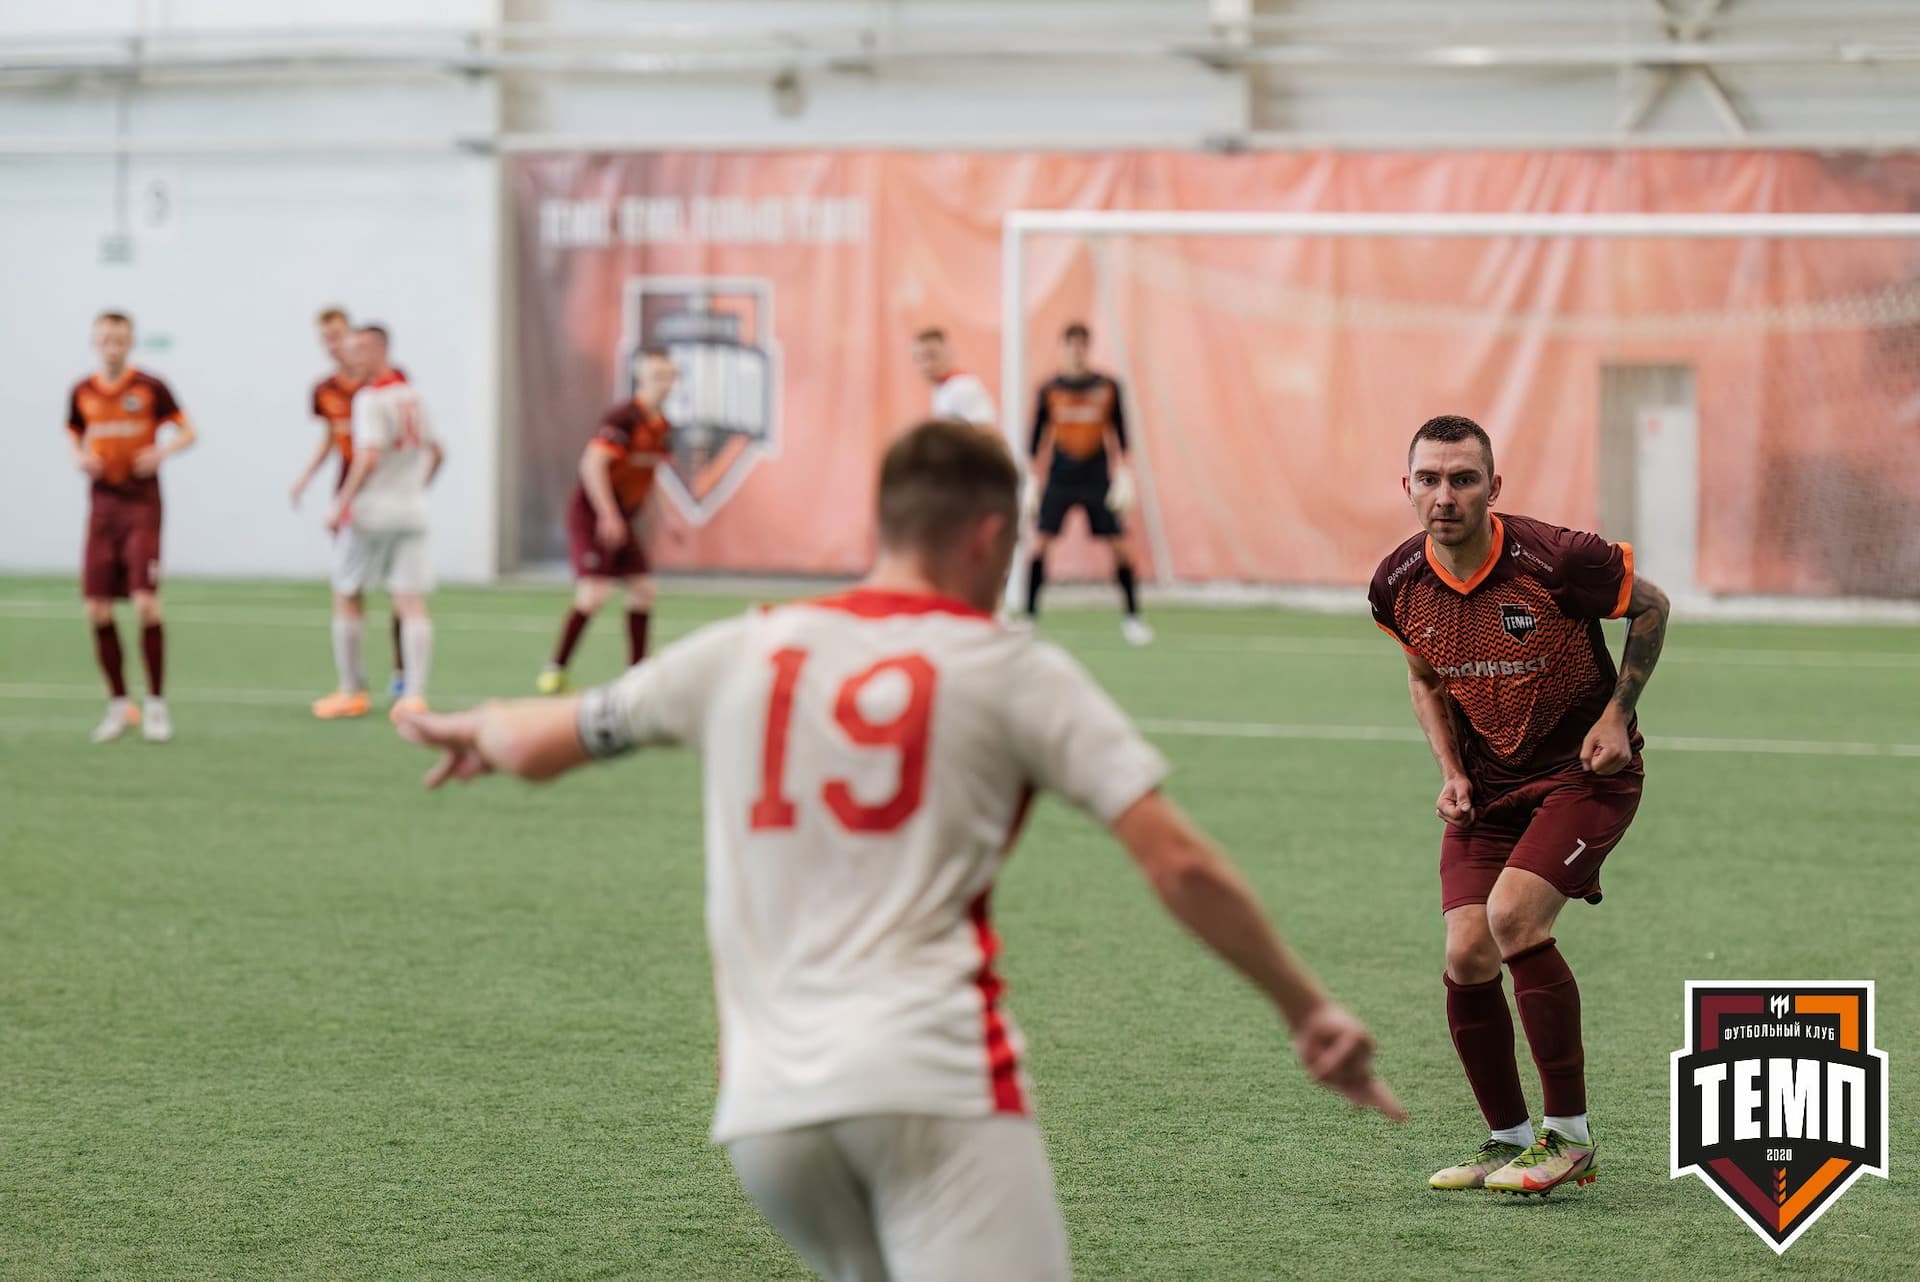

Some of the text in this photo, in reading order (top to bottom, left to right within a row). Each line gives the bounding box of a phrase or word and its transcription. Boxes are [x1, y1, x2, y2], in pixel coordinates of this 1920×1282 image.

[1504, 615, 1533, 630] ТЕМП
[751, 648, 937, 832] 19
[1564, 838, 1586, 866] 7
